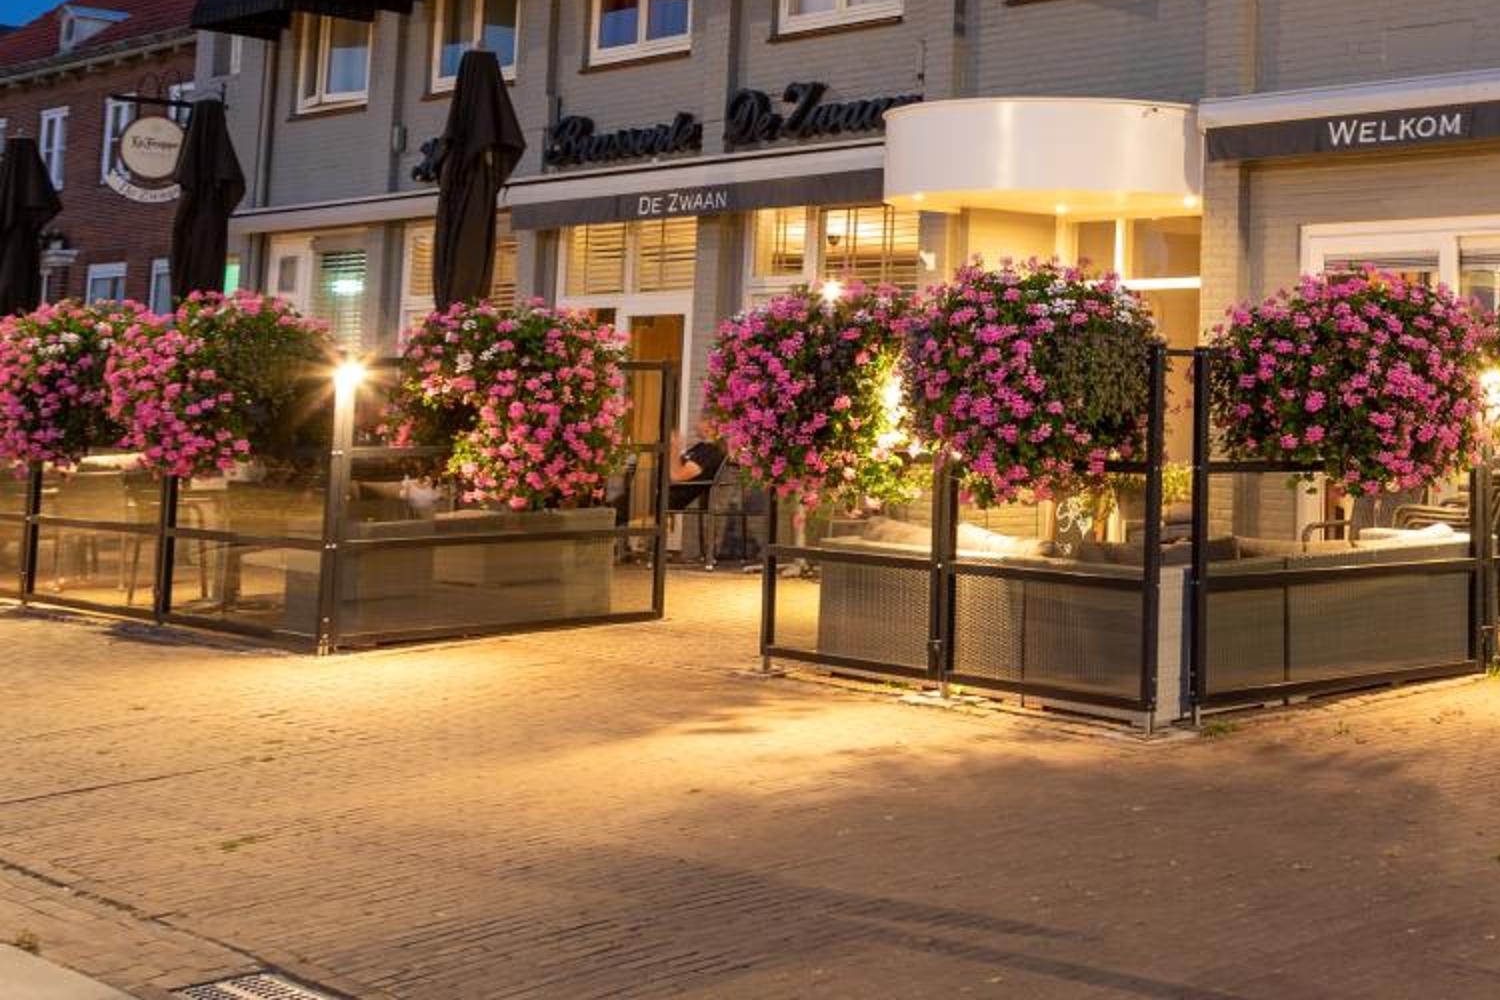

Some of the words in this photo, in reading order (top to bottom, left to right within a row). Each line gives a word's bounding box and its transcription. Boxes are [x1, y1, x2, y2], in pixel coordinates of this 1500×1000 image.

[1328, 113, 1462, 147] WELKOM
[638, 196, 662, 215] DE
[668, 190, 728, 213] ZWAAN
